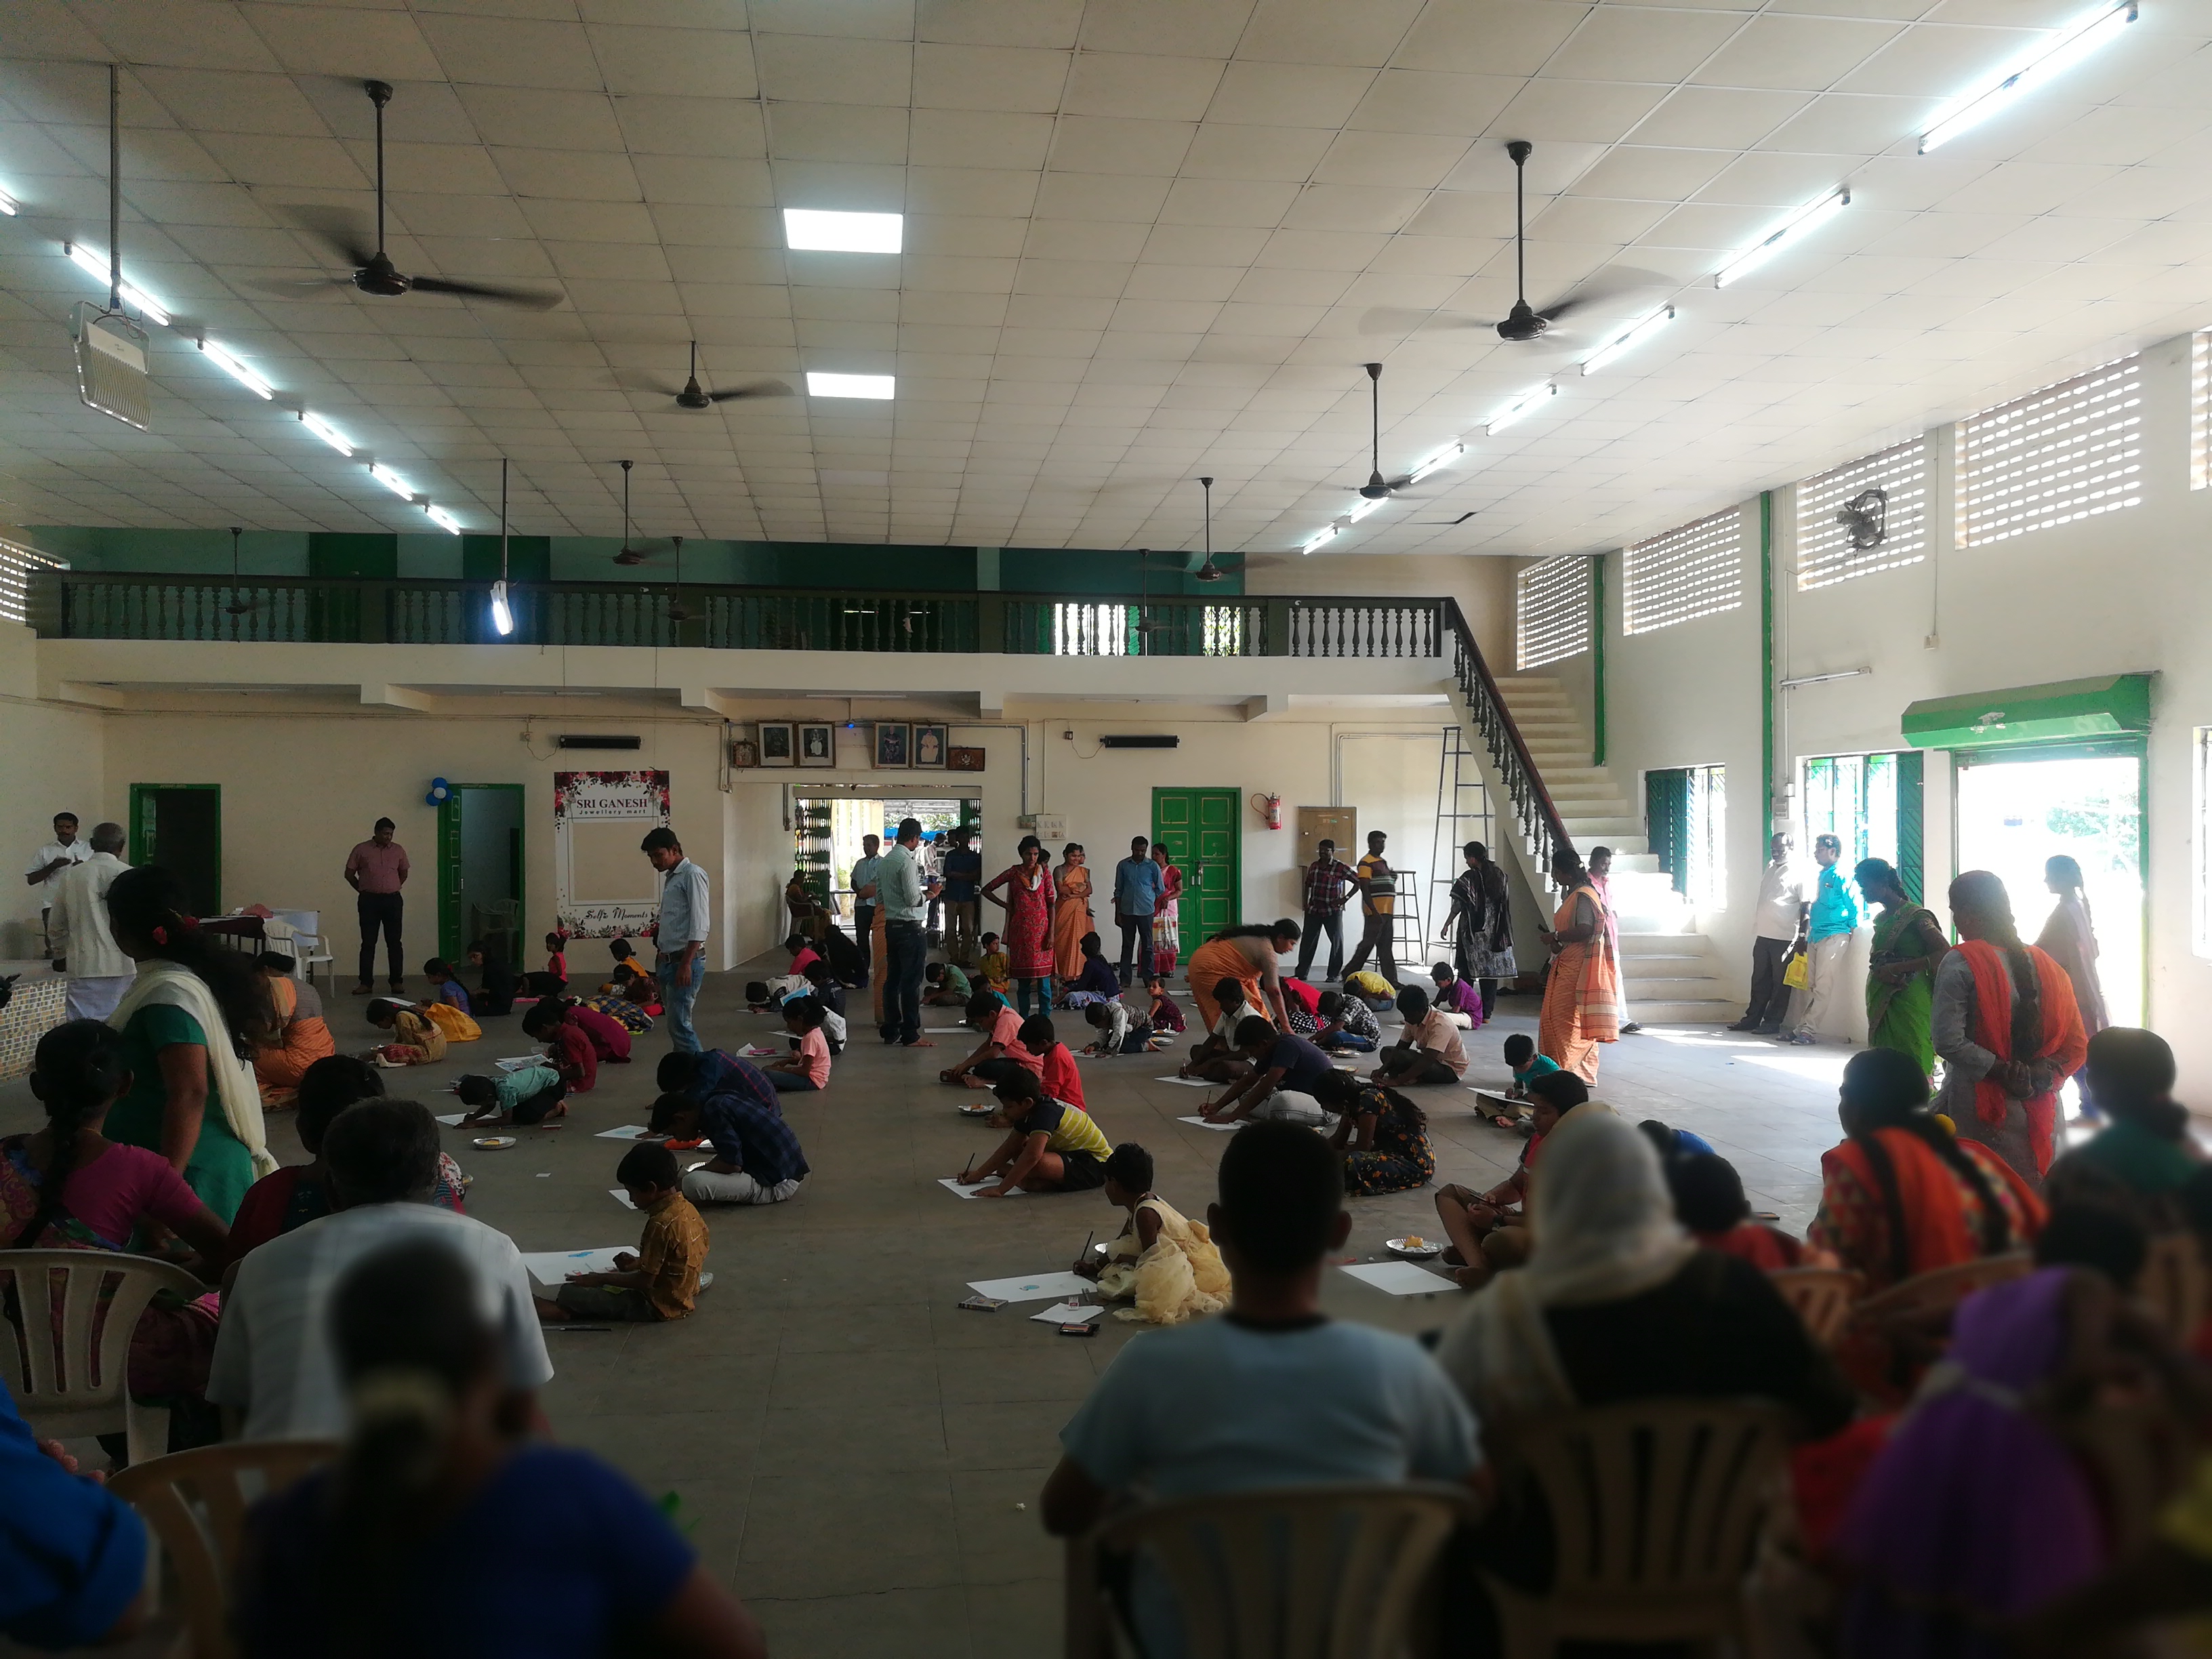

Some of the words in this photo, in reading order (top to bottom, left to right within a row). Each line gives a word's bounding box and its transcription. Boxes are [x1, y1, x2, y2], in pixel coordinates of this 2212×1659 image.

[577, 799, 596, 808] SRI
[599, 798, 647, 808] GANESH
[583, 909, 609, 922] Selfie
[612, 907, 648, 921] Moments
